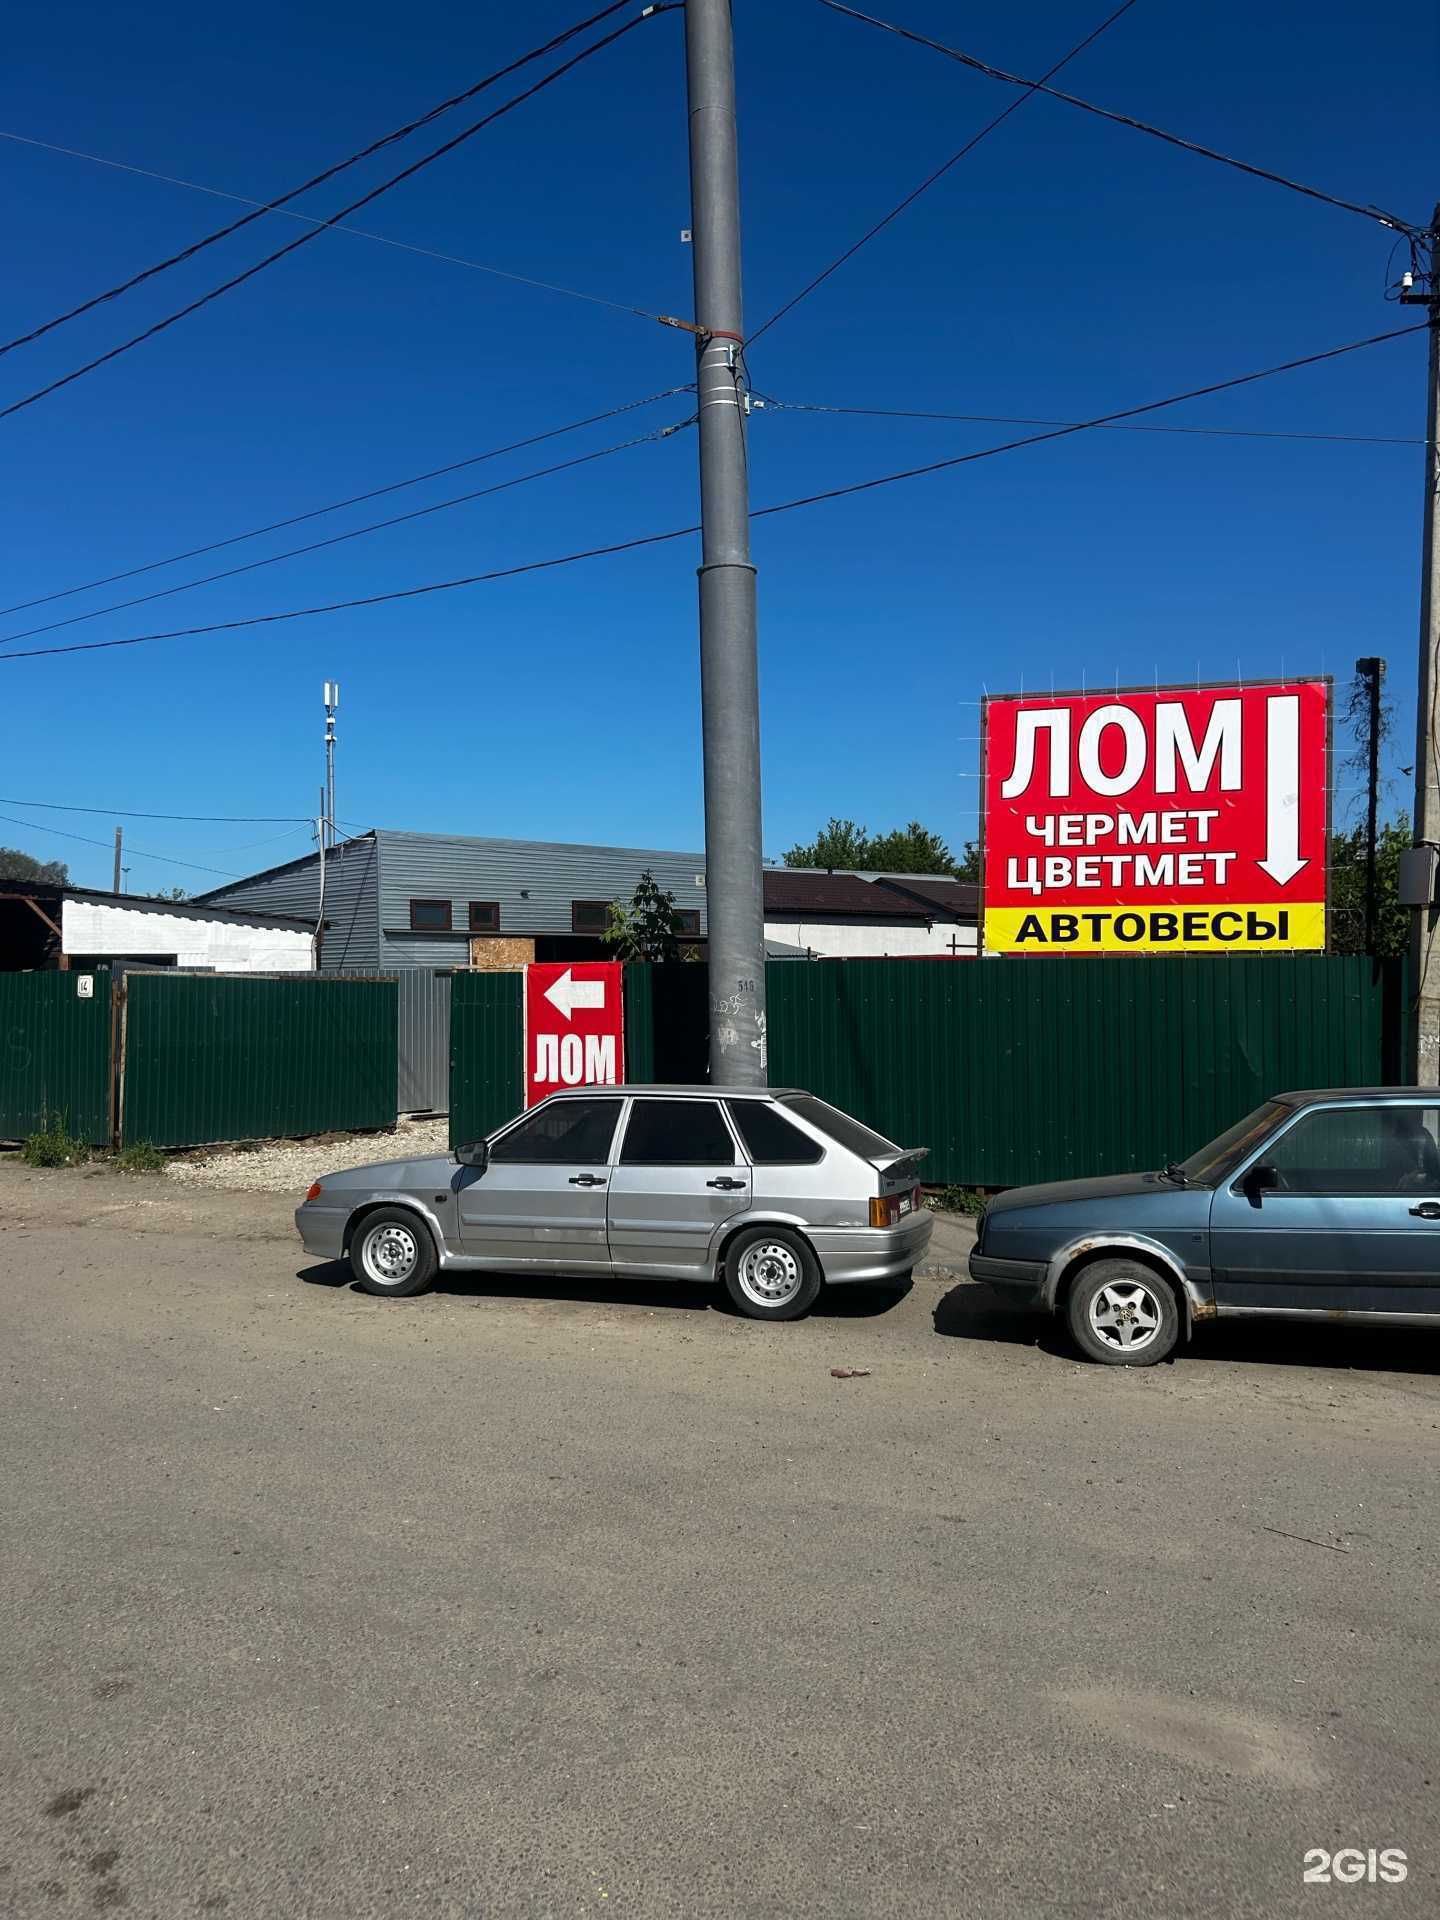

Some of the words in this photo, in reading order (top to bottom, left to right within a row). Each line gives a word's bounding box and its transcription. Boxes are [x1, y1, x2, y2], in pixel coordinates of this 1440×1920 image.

[1000, 697, 1243, 799] ЛОМ
[1025, 809, 1220, 847] ЧЕРМЕТ
[1006, 851, 1237, 896] ЦВЕТМЕТ
[1014, 910, 1289, 943] АВТОВЕСЫ
[533, 1033, 616, 1085] ЛОМ
